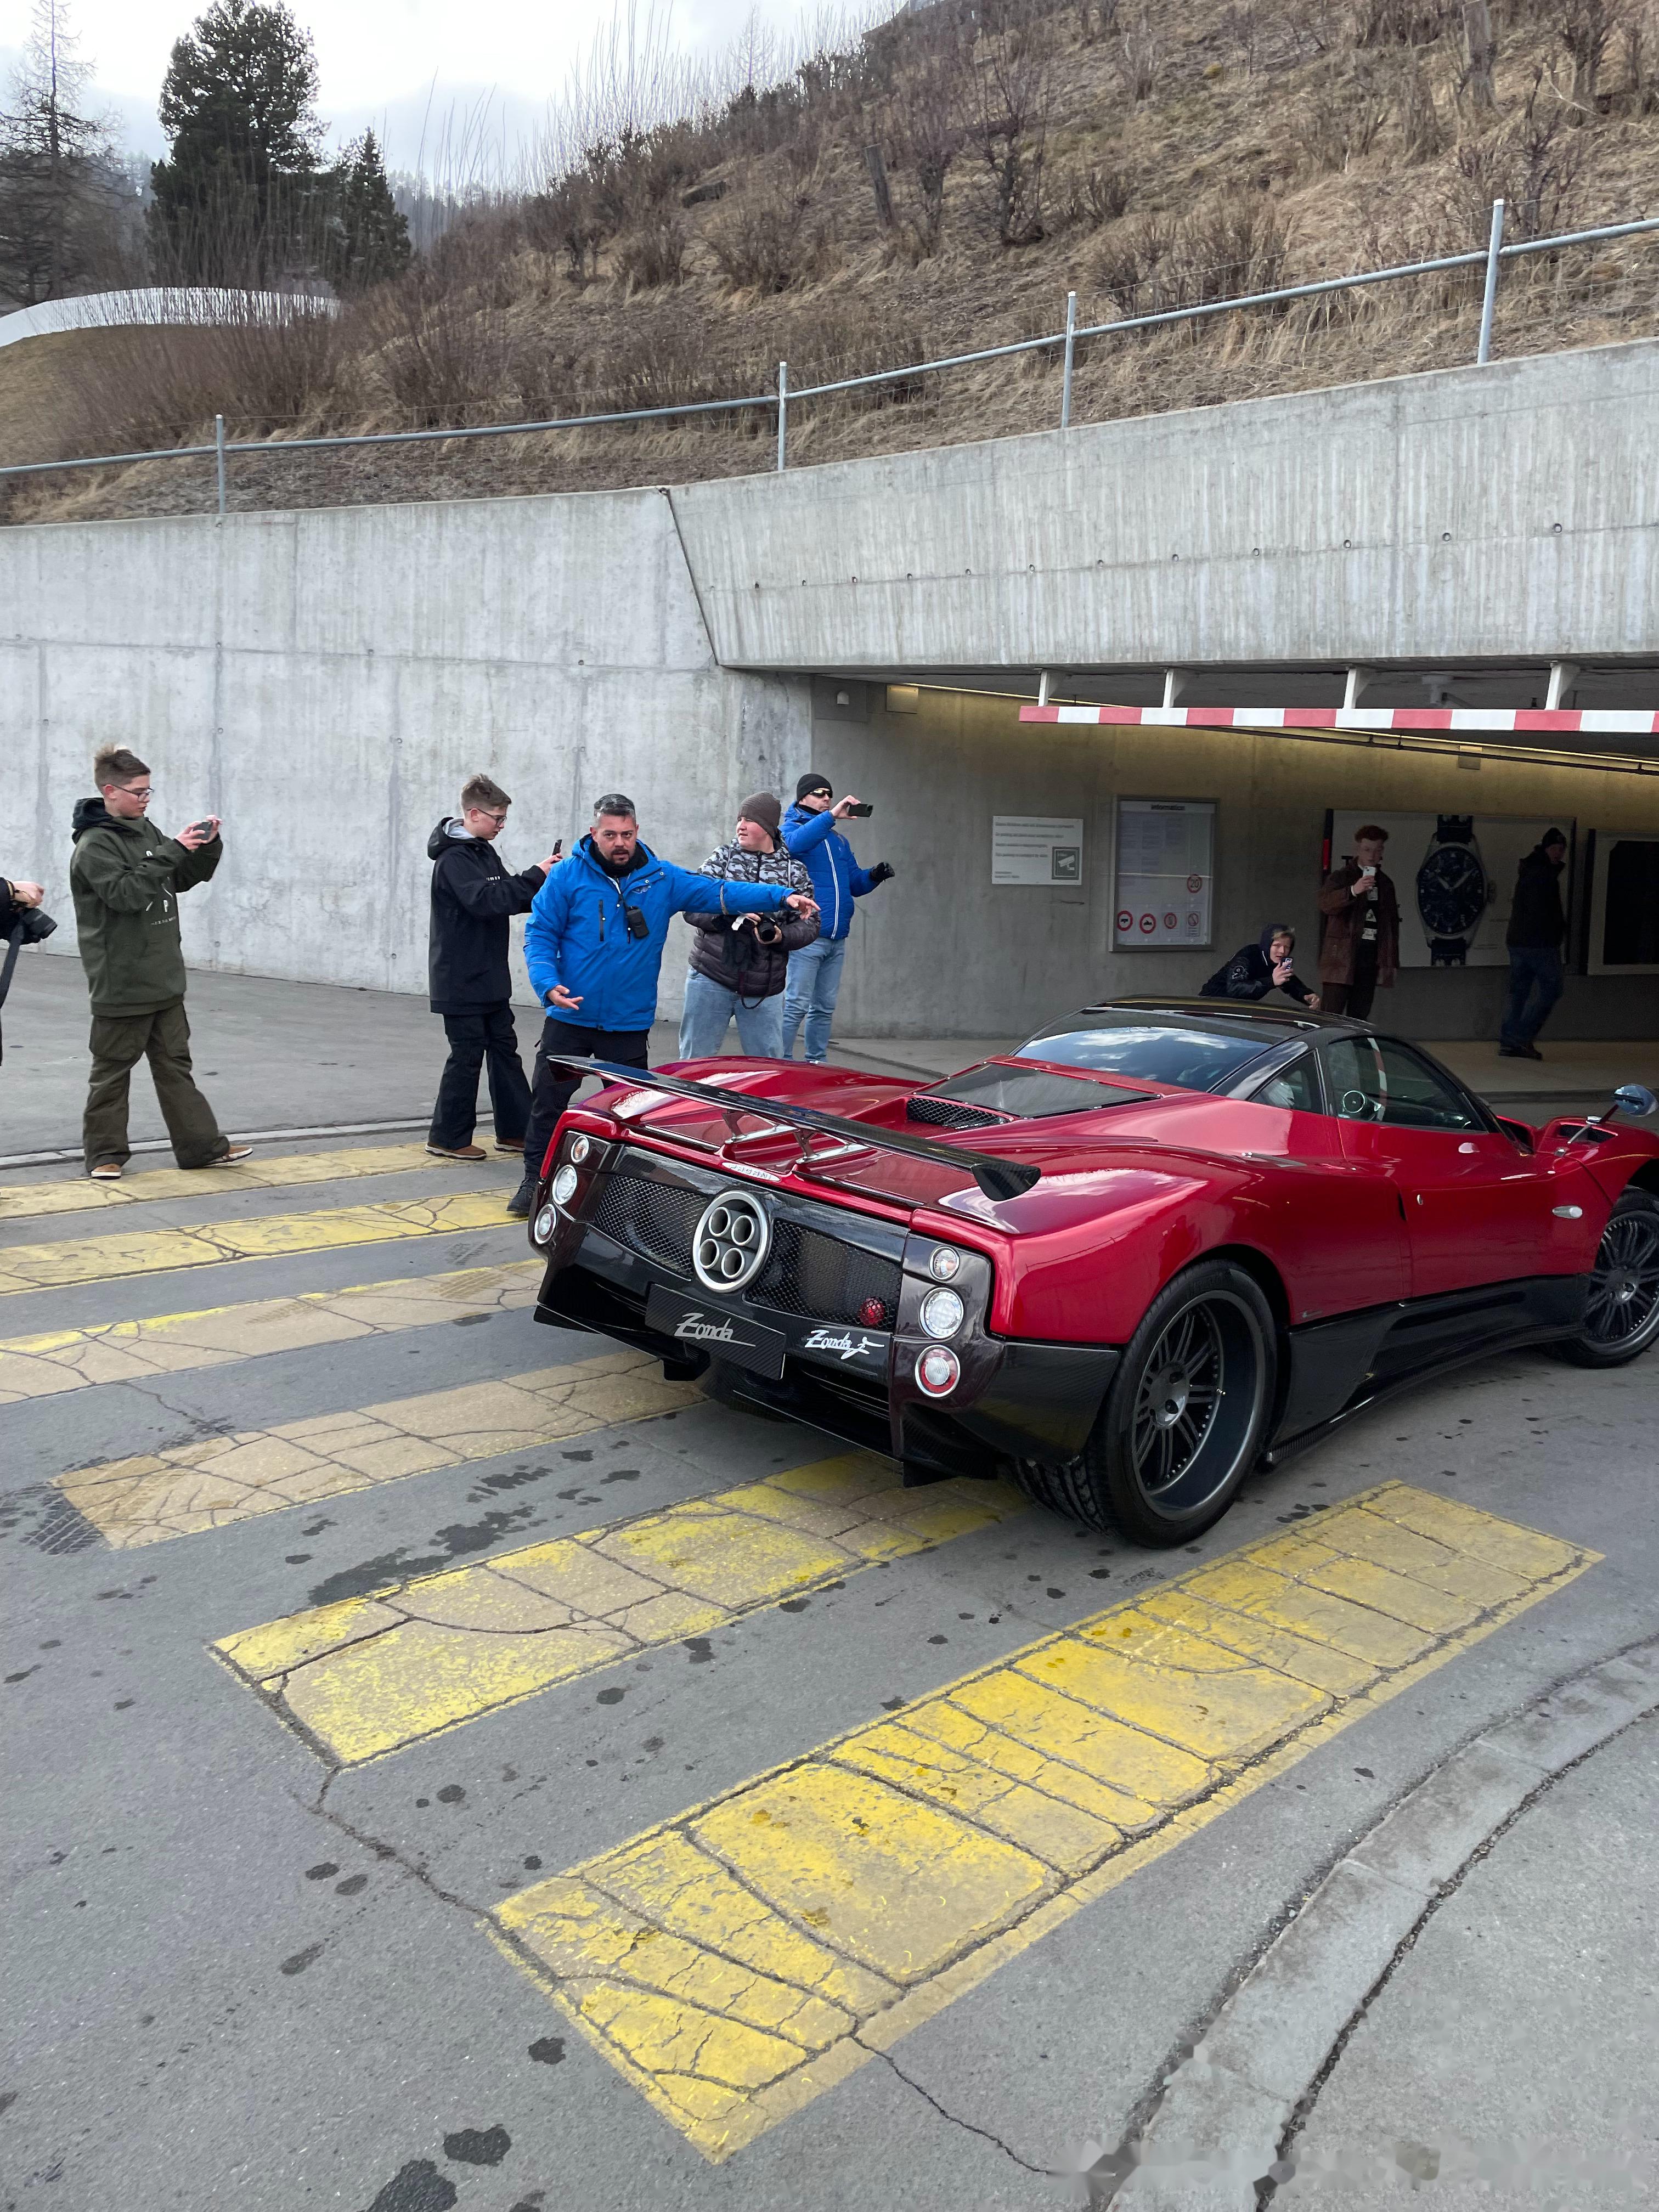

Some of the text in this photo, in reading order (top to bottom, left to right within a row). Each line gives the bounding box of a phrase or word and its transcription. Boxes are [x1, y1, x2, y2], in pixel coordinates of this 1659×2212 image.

[1190, 878, 1199, 888] 20
[729, 1164, 772, 1180] PAGANI
[674, 1312, 757, 1347] Zonda
[804, 1329, 853, 1351] Zonda
